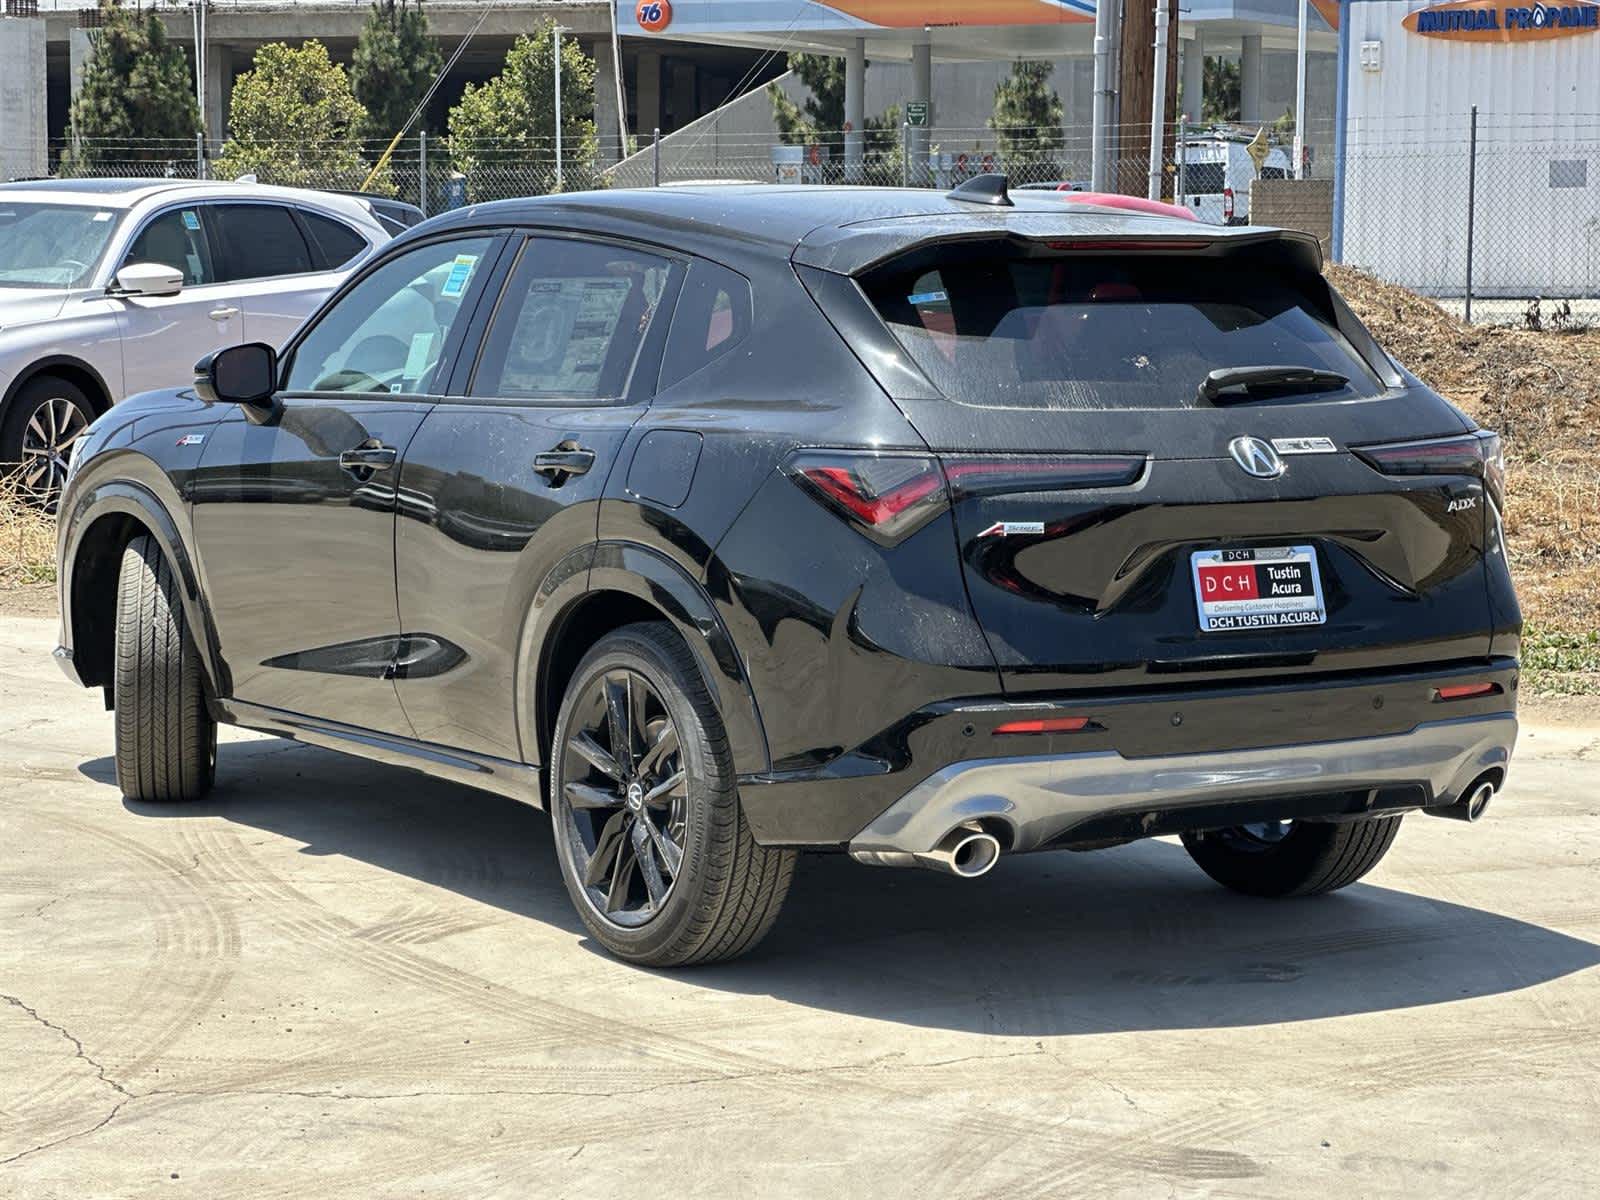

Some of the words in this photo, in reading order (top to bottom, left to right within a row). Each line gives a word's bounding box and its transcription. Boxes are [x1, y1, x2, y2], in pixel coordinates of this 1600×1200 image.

[640, 3, 662, 23] 76
[1417, 9, 1500, 33] MUTUAL
[1504, 3, 1599, 29] PROPANE
[1447, 497, 1476, 512] ADX
[1228, 551, 1250, 560] DCH
[1267, 566, 1301, 580] Tustin
[1205, 575, 1251, 592] DCH
[1271, 582, 1302, 595] Acura
[1209, 617, 1234, 628] DCH
[1236, 614, 1278, 626] TUSTIN
[1280, 611, 1319, 624] ACURA
